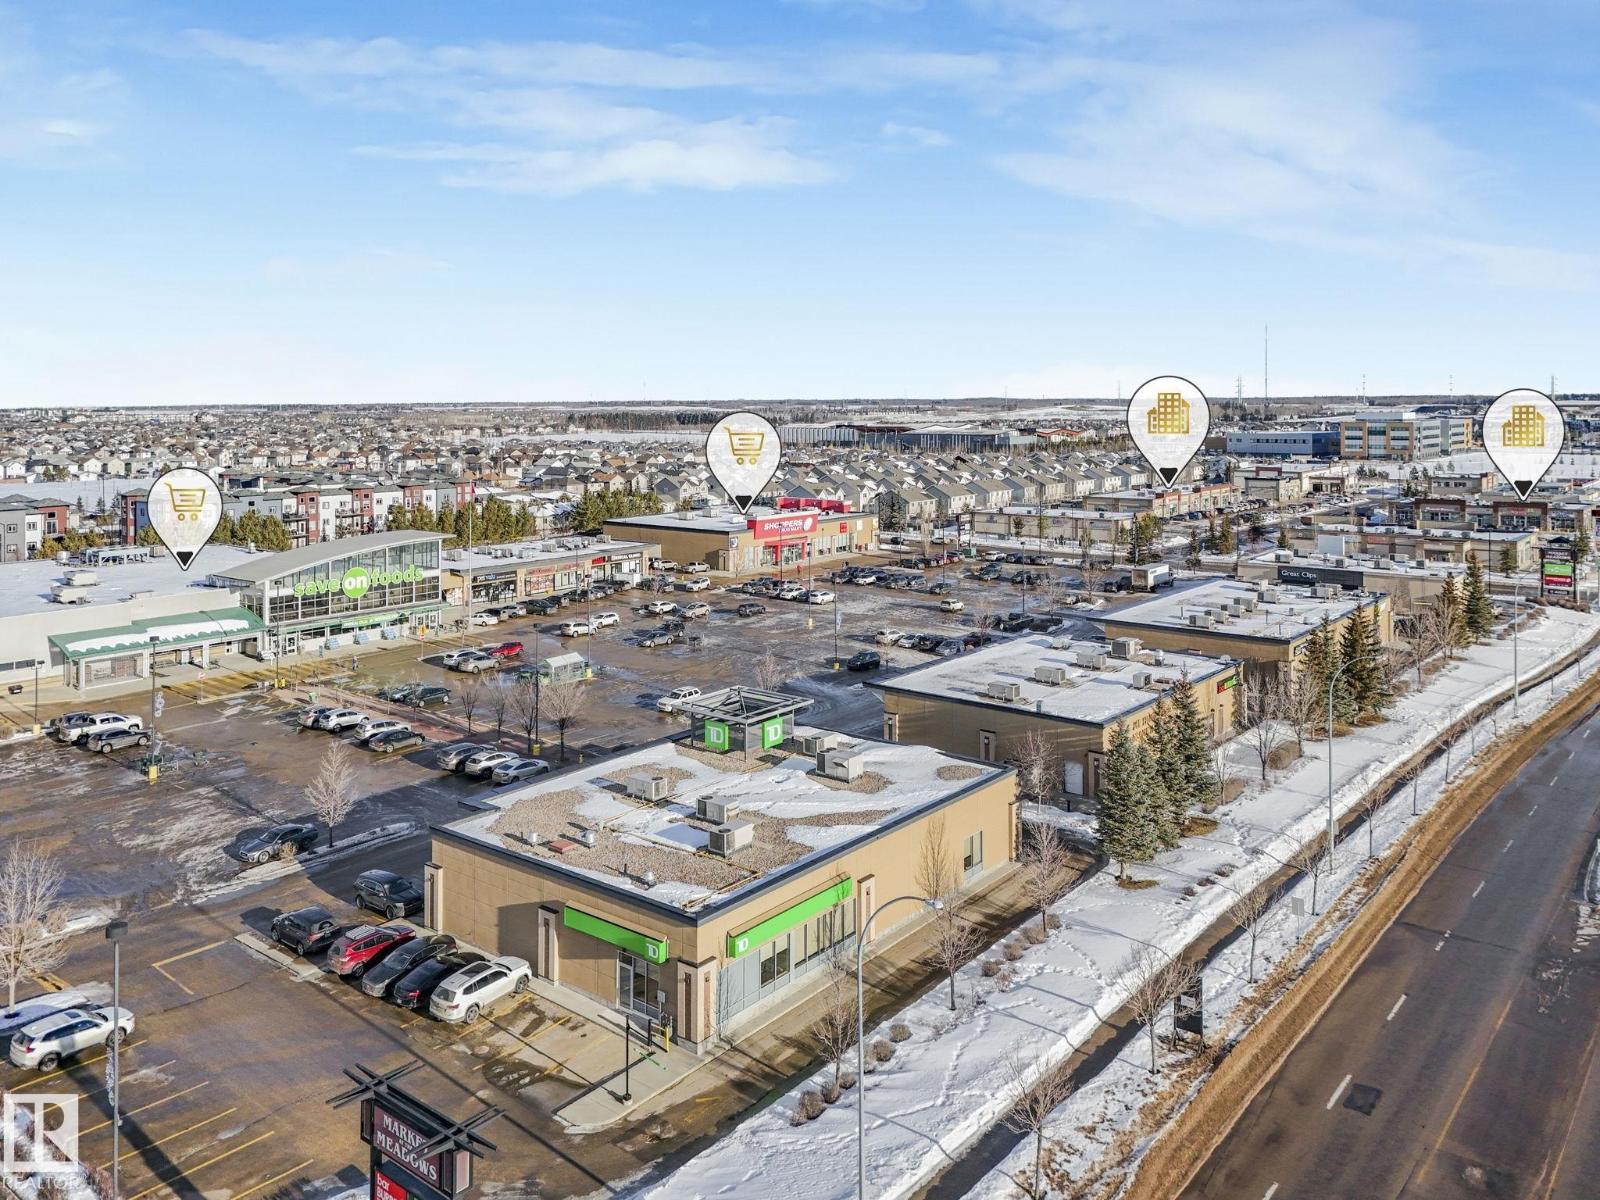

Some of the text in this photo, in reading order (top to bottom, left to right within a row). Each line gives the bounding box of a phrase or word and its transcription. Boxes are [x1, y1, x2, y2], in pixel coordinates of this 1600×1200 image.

[294, 564, 425, 598] save on foods
[1301, 571, 1317, 579] Clips
[707, 726, 724, 744] TD
[767, 725, 780, 741] TD
[647, 944, 657, 957] TD
[737, 938, 748, 952] TD
[383, 1114, 428, 1153] MARKE
[377, 1130, 437, 1180] MEADOWS
